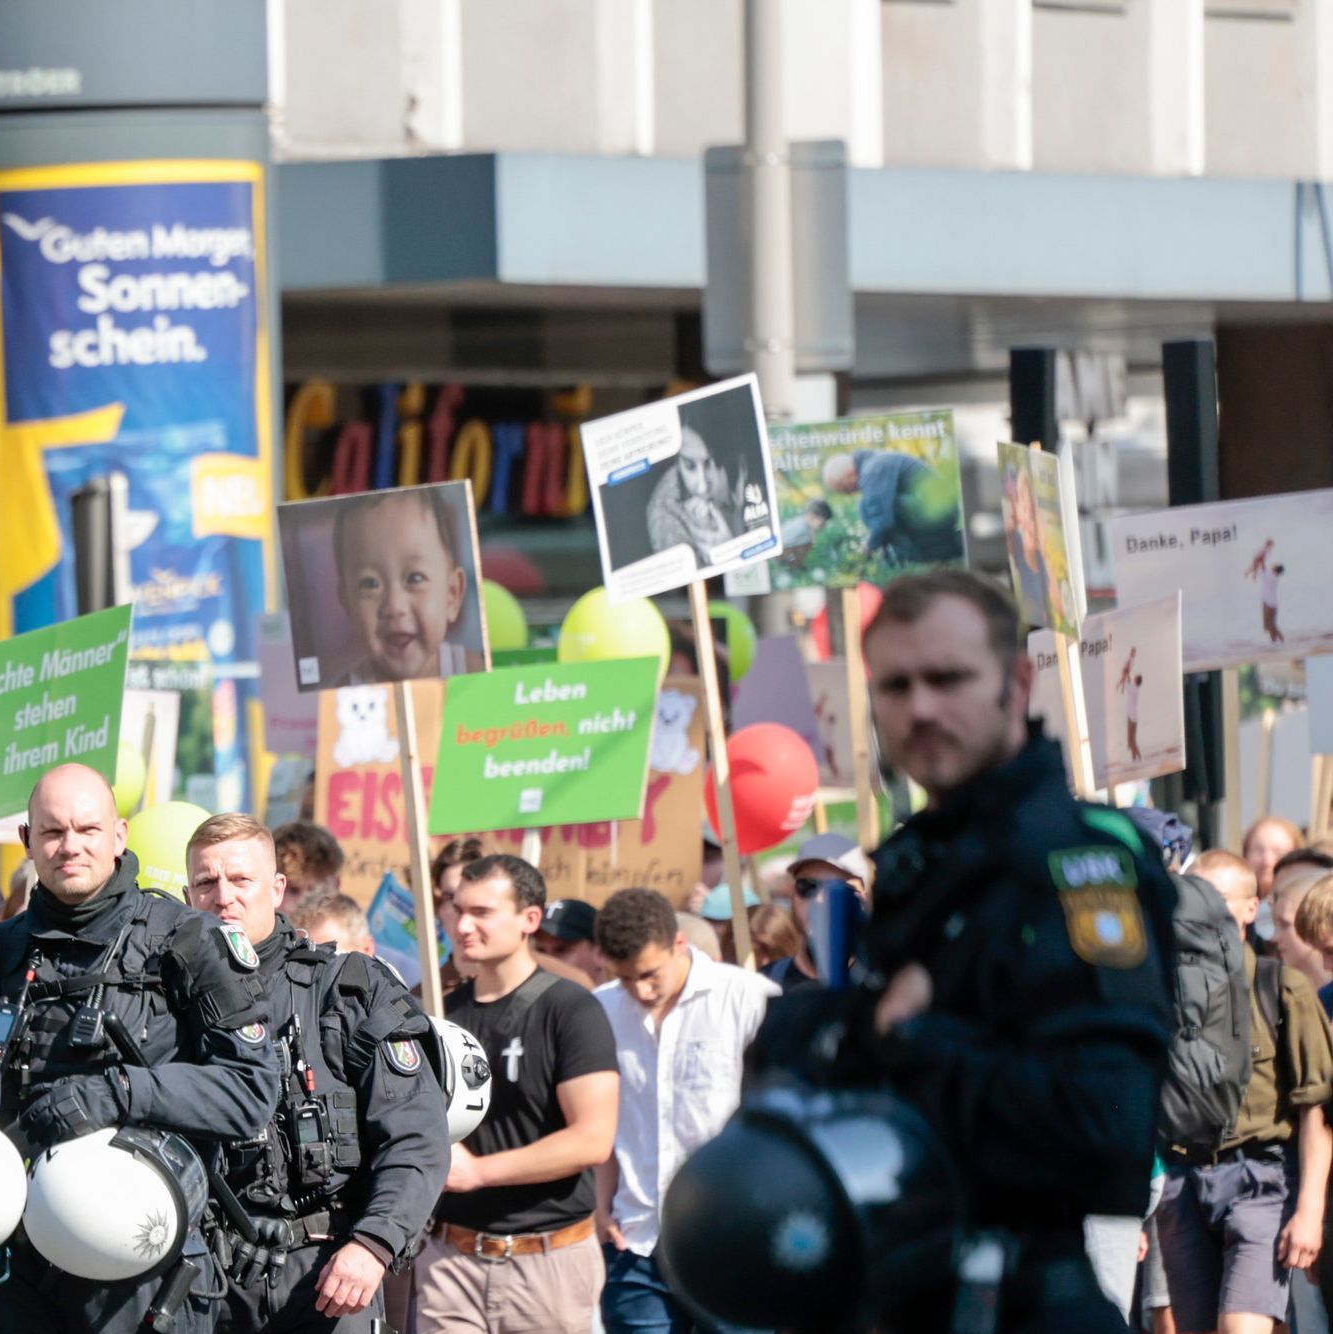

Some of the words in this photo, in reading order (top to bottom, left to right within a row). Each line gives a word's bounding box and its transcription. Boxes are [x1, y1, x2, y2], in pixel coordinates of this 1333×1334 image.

[888, 419, 946, 440] kennt
[1125, 532, 1184, 554] Danke,
[1189, 524, 1238, 546] Papa!
[514, 677, 588, 705] Leben
[14, 691, 77, 732] stehen
[577, 706, 637, 736] nicht
[3, 742, 59, 776] ihrem
[64, 714, 110, 759] Kind
[483, 746, 592, 780] beenden!
